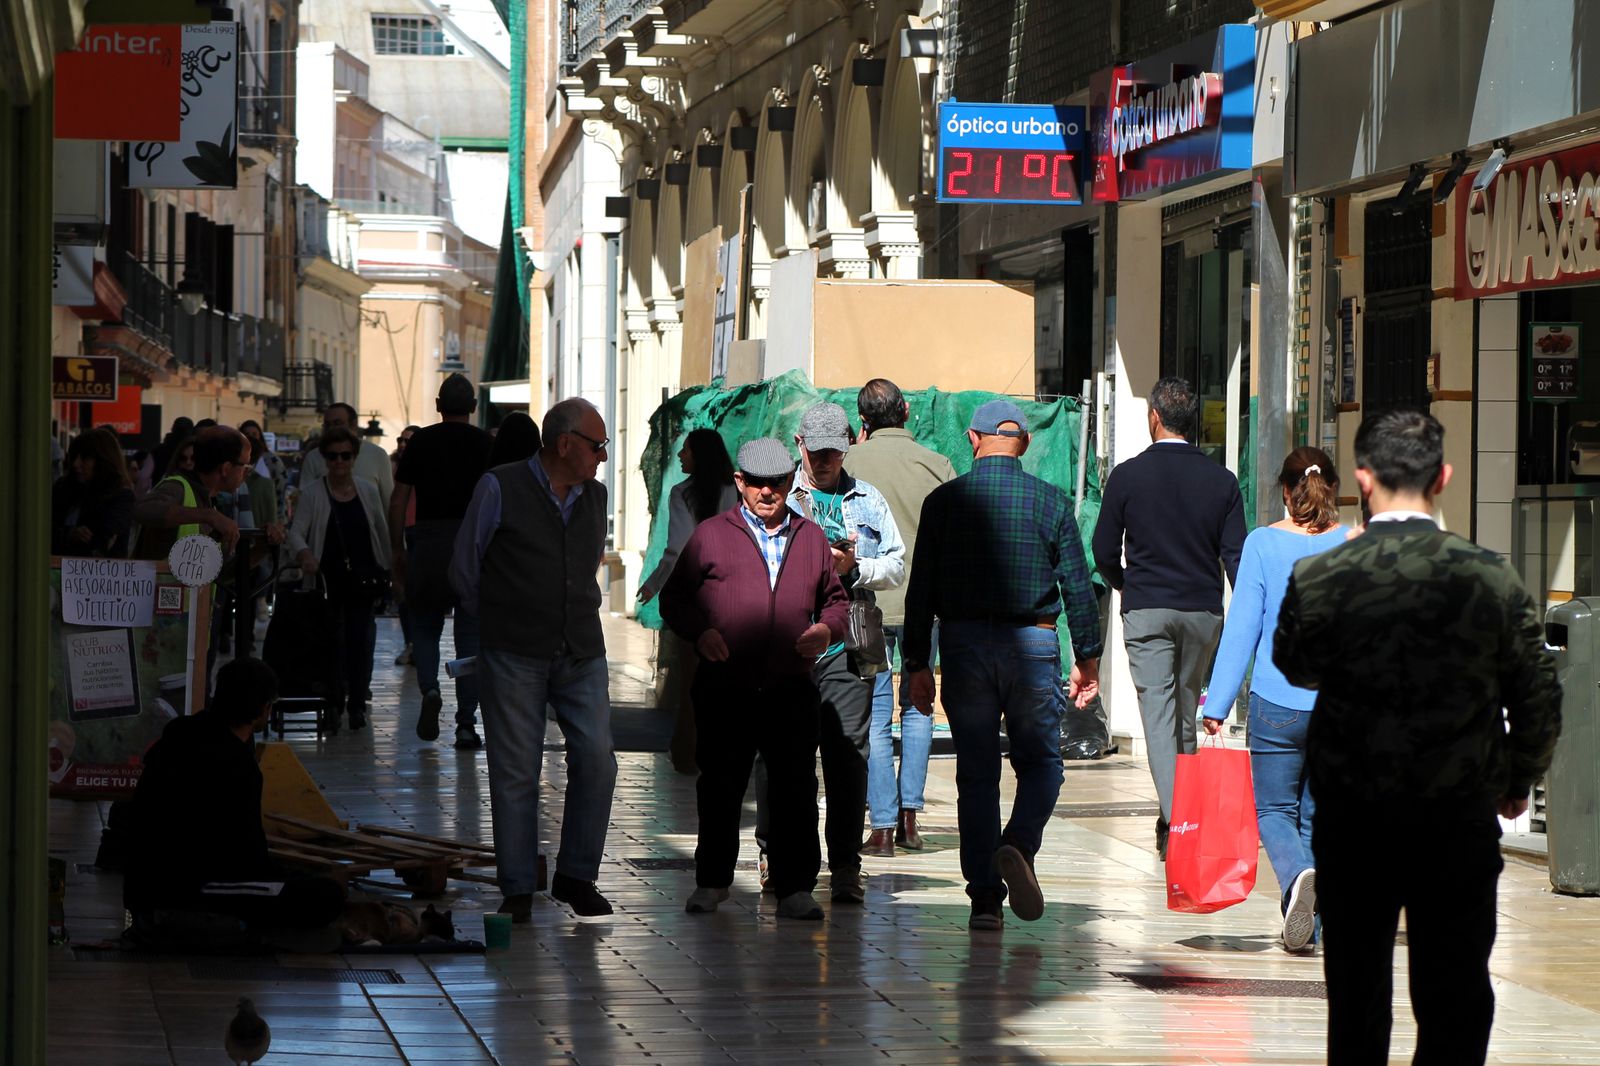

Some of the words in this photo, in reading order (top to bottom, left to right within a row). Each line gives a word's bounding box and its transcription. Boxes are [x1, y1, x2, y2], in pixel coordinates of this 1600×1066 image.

[185, 25, 212, 34] Desde
[214, 26, 235, 35] 1992
[947, 113, 1007, 136] óptica
[1012, 117, 1078, 135] urbano
[183, 538, 209, 561] PIDE
[124, 562, 137, 577] DE
[178, 561, 203, 579] CITA
[65, 577, 153, 597] ASESORAMIENTO
[72, 636, 99, 648] CLUB
[76, 776, 109, 787] ELIGE
[111, 777, 127, 788] TU
